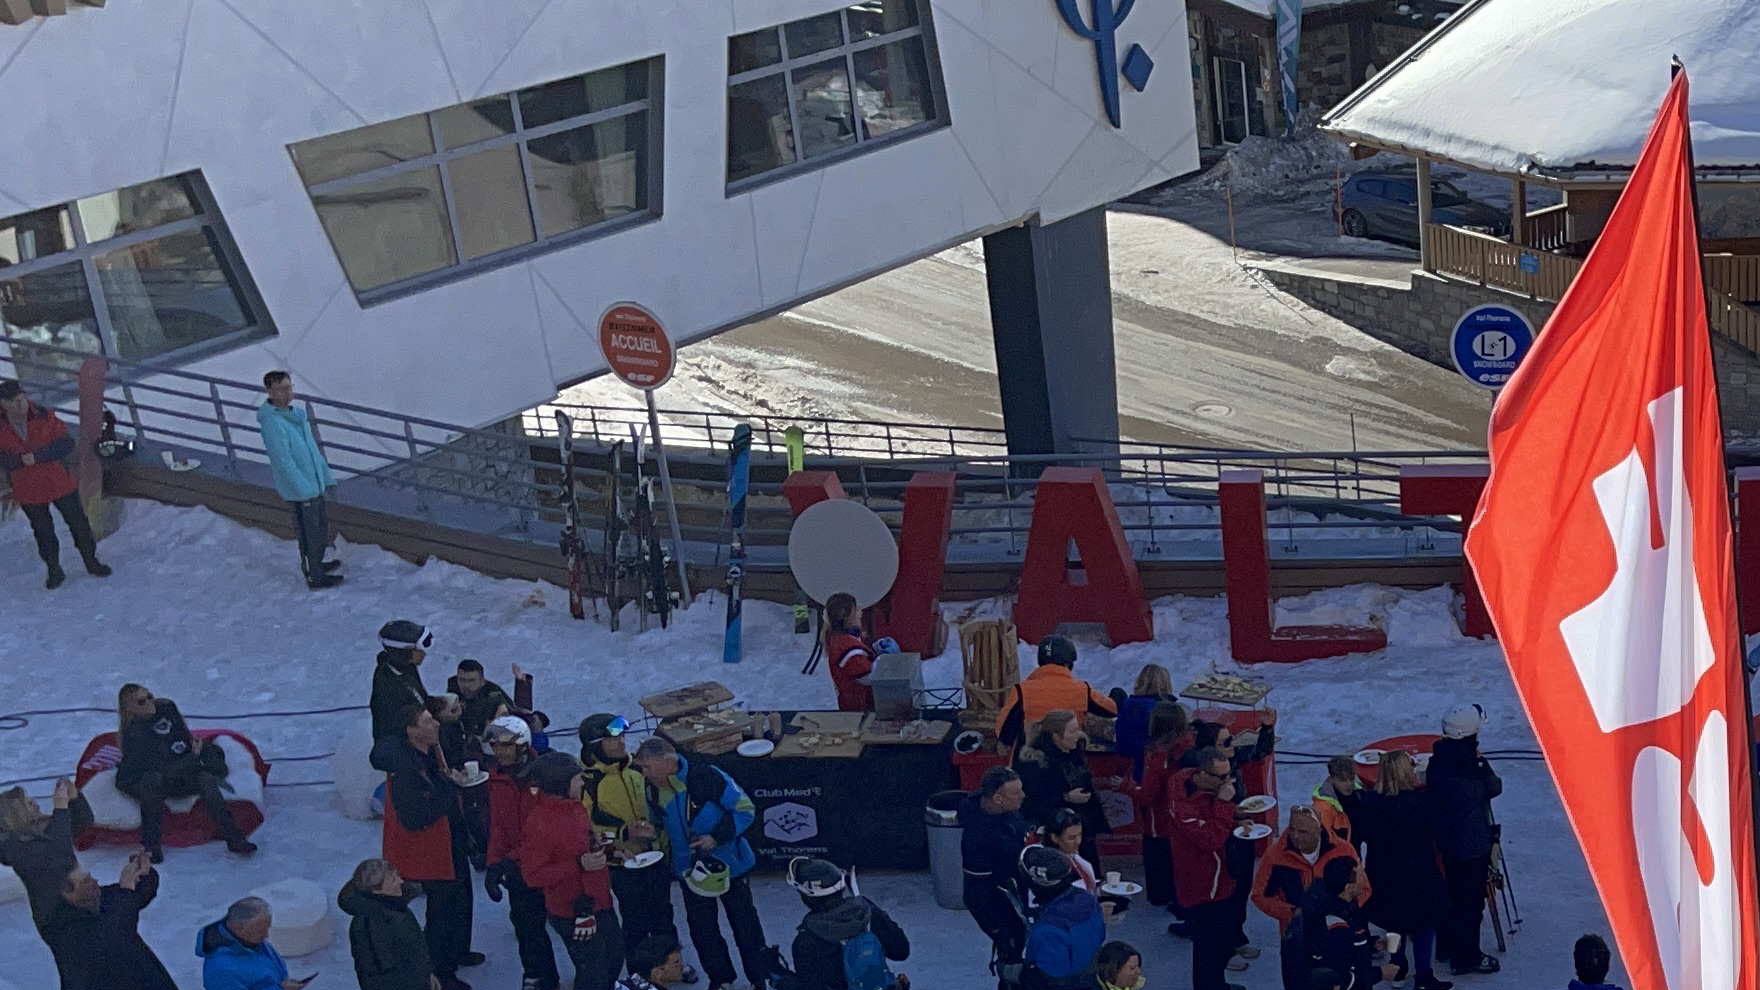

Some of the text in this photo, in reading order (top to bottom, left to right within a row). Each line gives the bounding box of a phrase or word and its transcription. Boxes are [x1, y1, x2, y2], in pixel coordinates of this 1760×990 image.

[611, 333, 661, 353] ACCUEIL
[1482, 334, 1507, 357] L1
[754, 788, 811, 797] Club Med
